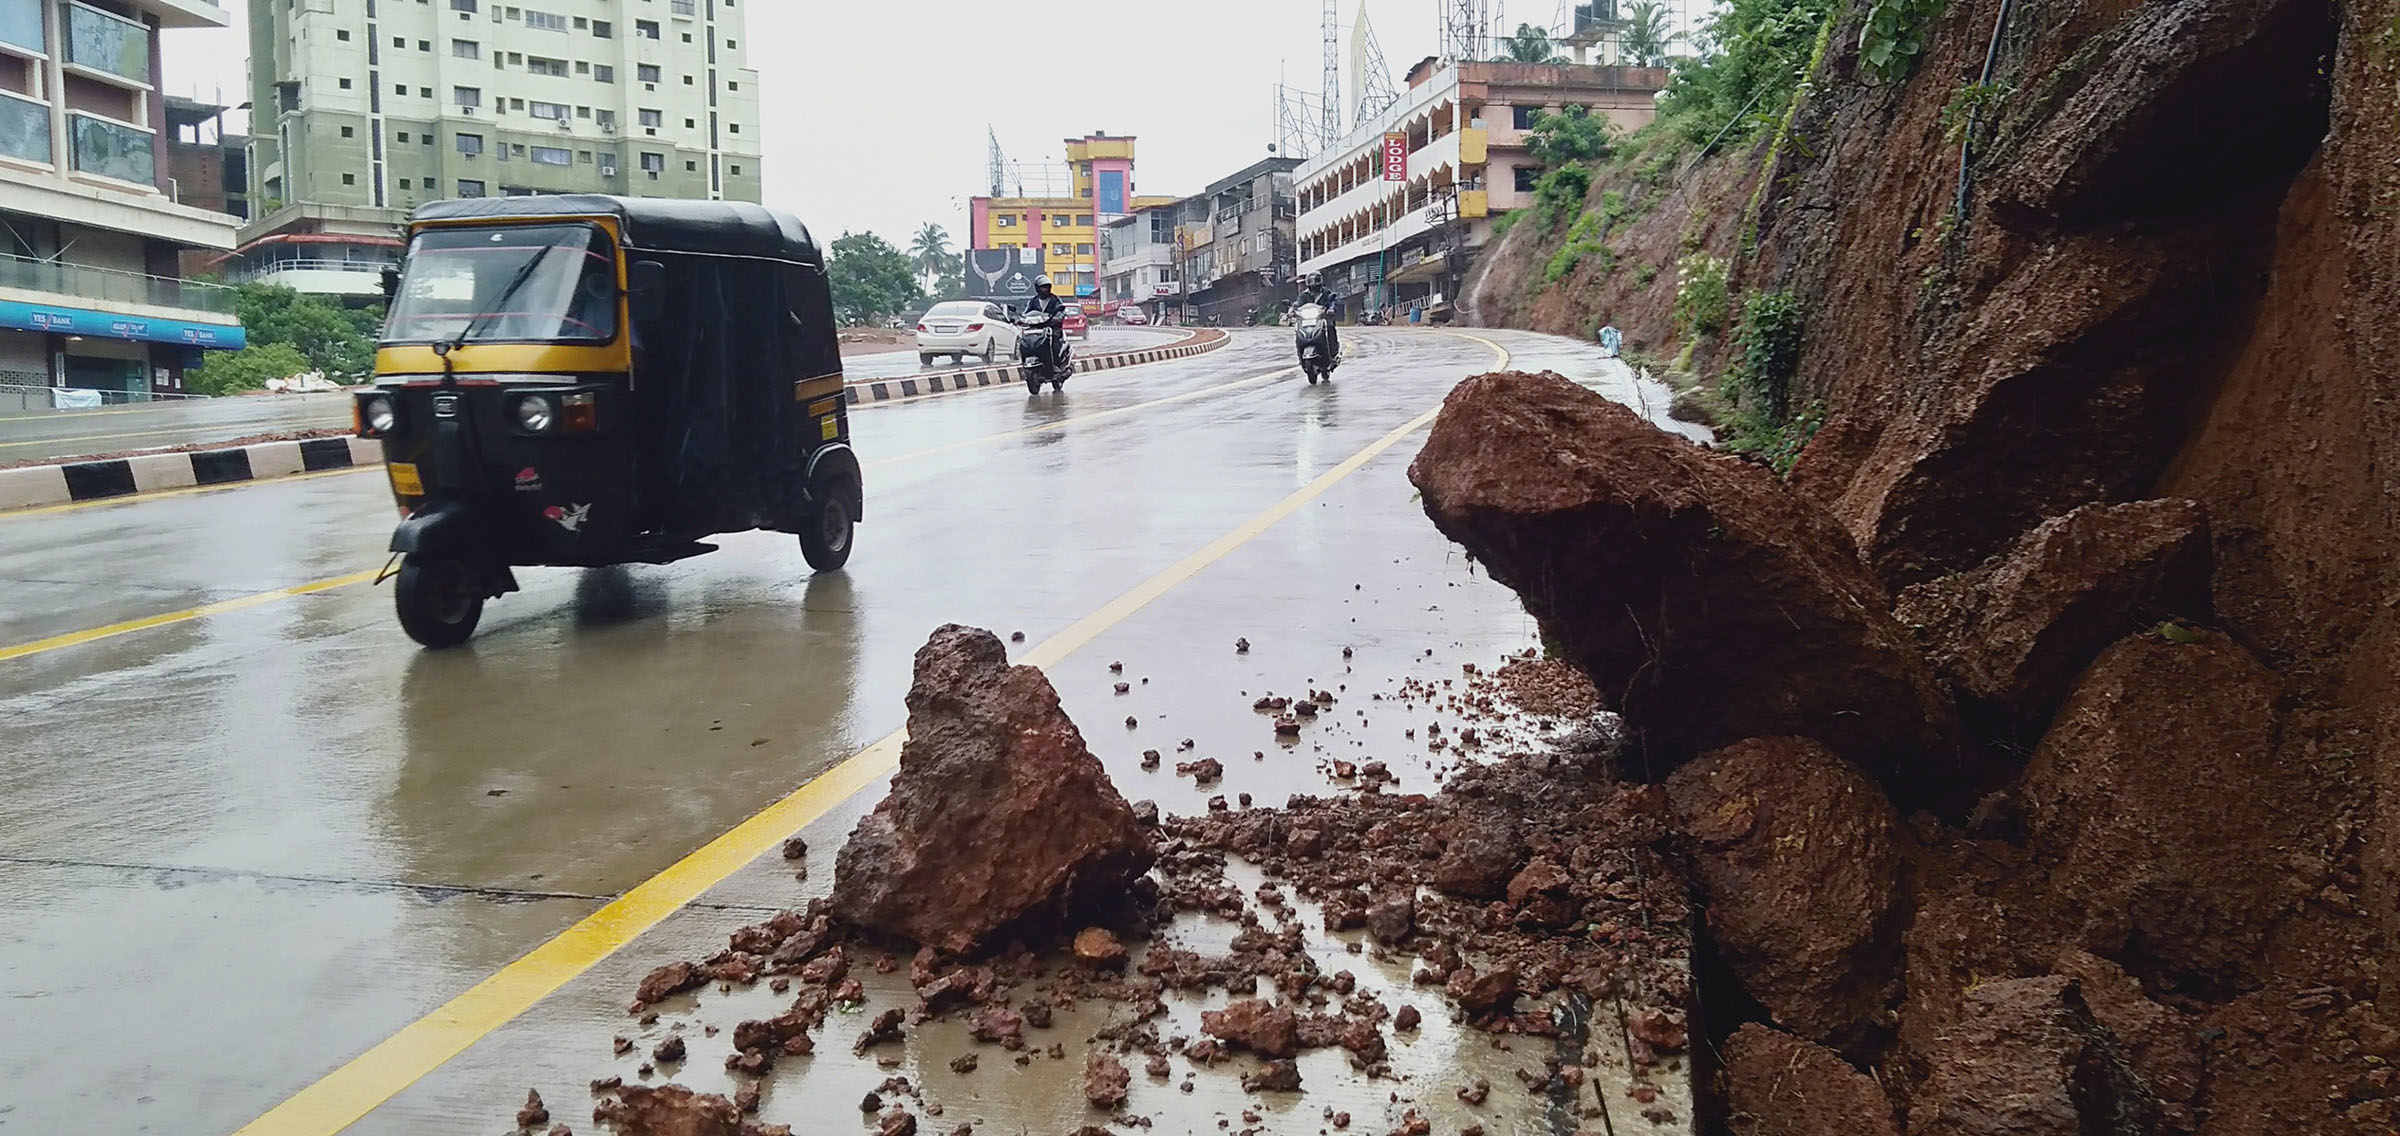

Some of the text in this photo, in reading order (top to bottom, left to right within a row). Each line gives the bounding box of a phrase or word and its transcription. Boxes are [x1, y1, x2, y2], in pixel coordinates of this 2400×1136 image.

[1388, 139, 1403, 180] LODGE
[33, 314, 71, 325] YES BANK
[183, 329, 215, 339] YES BANK
